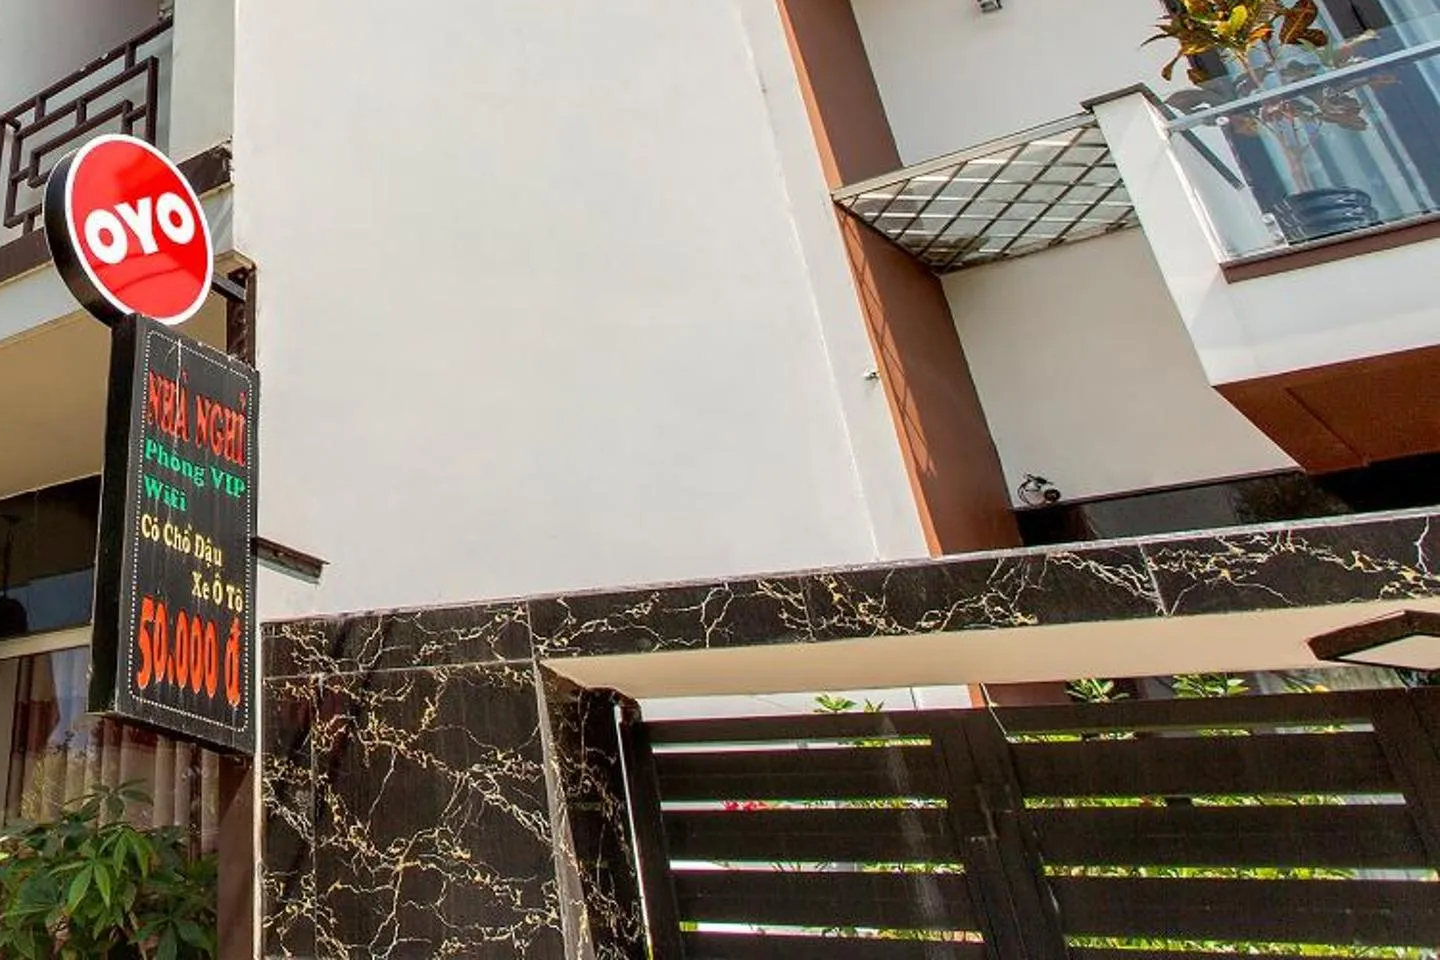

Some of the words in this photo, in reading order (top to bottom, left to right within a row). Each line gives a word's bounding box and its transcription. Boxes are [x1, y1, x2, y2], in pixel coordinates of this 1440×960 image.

[84, 191, 196, 265] OYO
[143, 473, 188, 512] Wifi
[209, 465, 246, 499] VIP
[191, 571, 210, 600] Xe
[212, 572, 223, 606] Ô
[226, 583, 243, 613] Tô
[136, 595, 217, 696] 50.000
